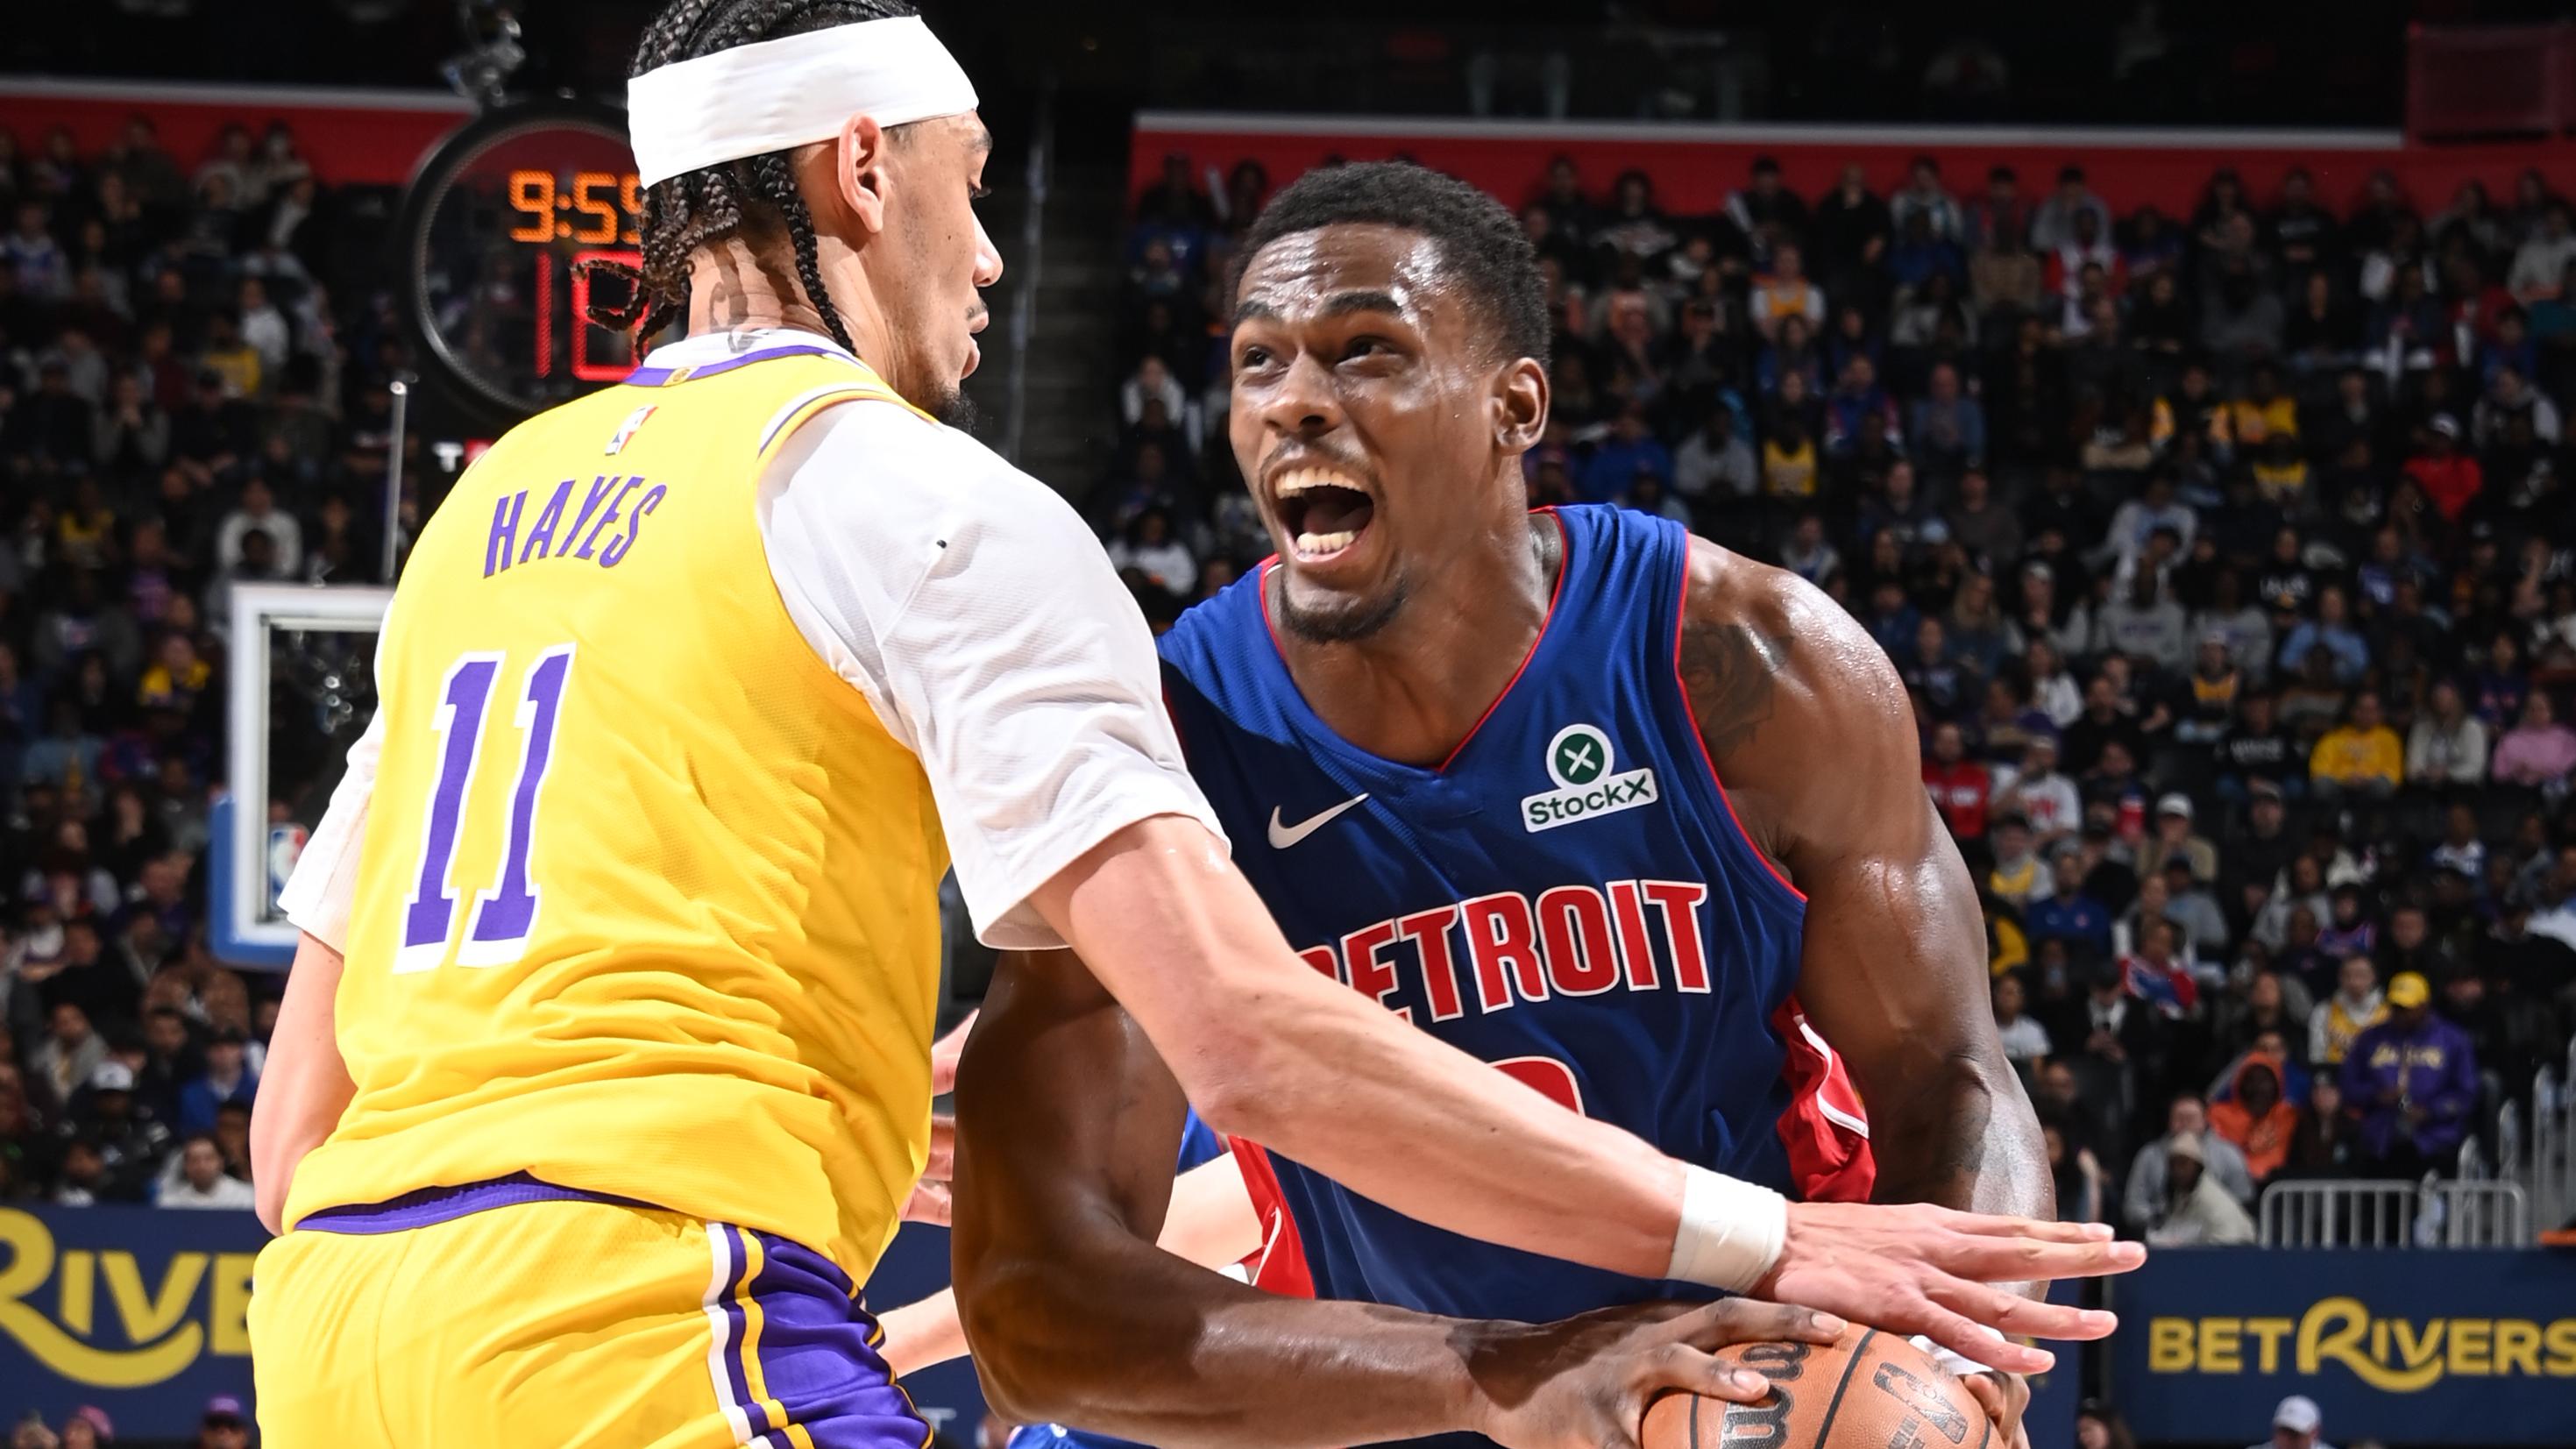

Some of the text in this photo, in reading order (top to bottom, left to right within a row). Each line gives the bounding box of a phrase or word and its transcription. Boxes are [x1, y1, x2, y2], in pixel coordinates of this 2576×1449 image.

[483, 475, 667, 579] HAYES
[392, 641, 578, 975] 11
[1528, 773, 1651, 825] StockX
